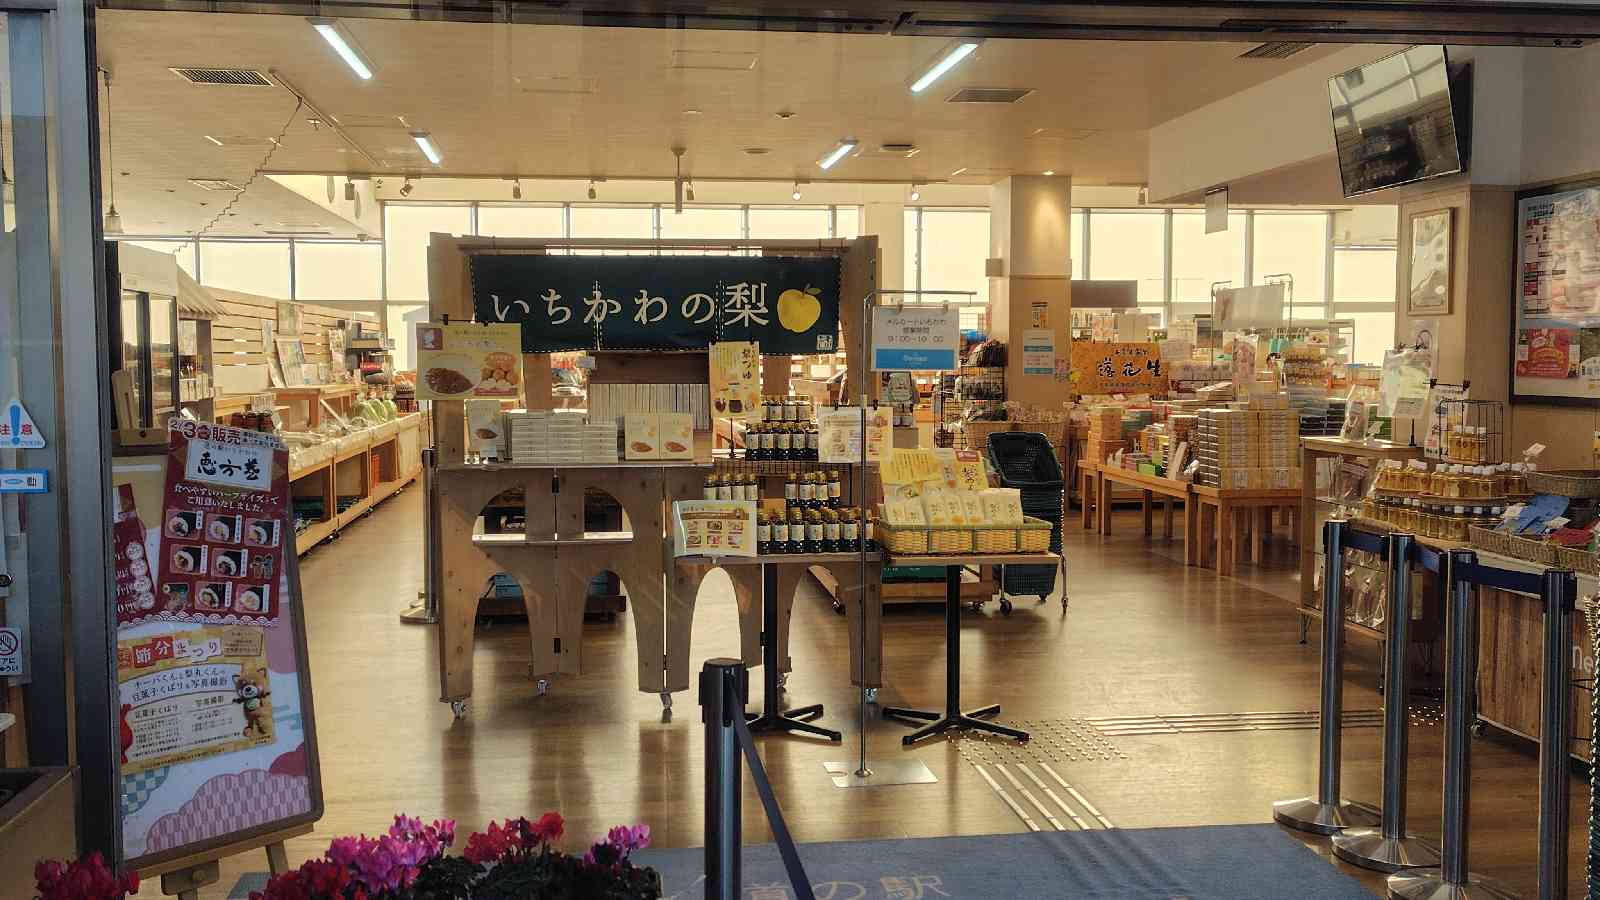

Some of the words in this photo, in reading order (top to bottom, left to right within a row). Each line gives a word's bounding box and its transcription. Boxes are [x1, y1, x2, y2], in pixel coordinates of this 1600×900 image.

[491, 280, 769, 328] いちかわの梨
